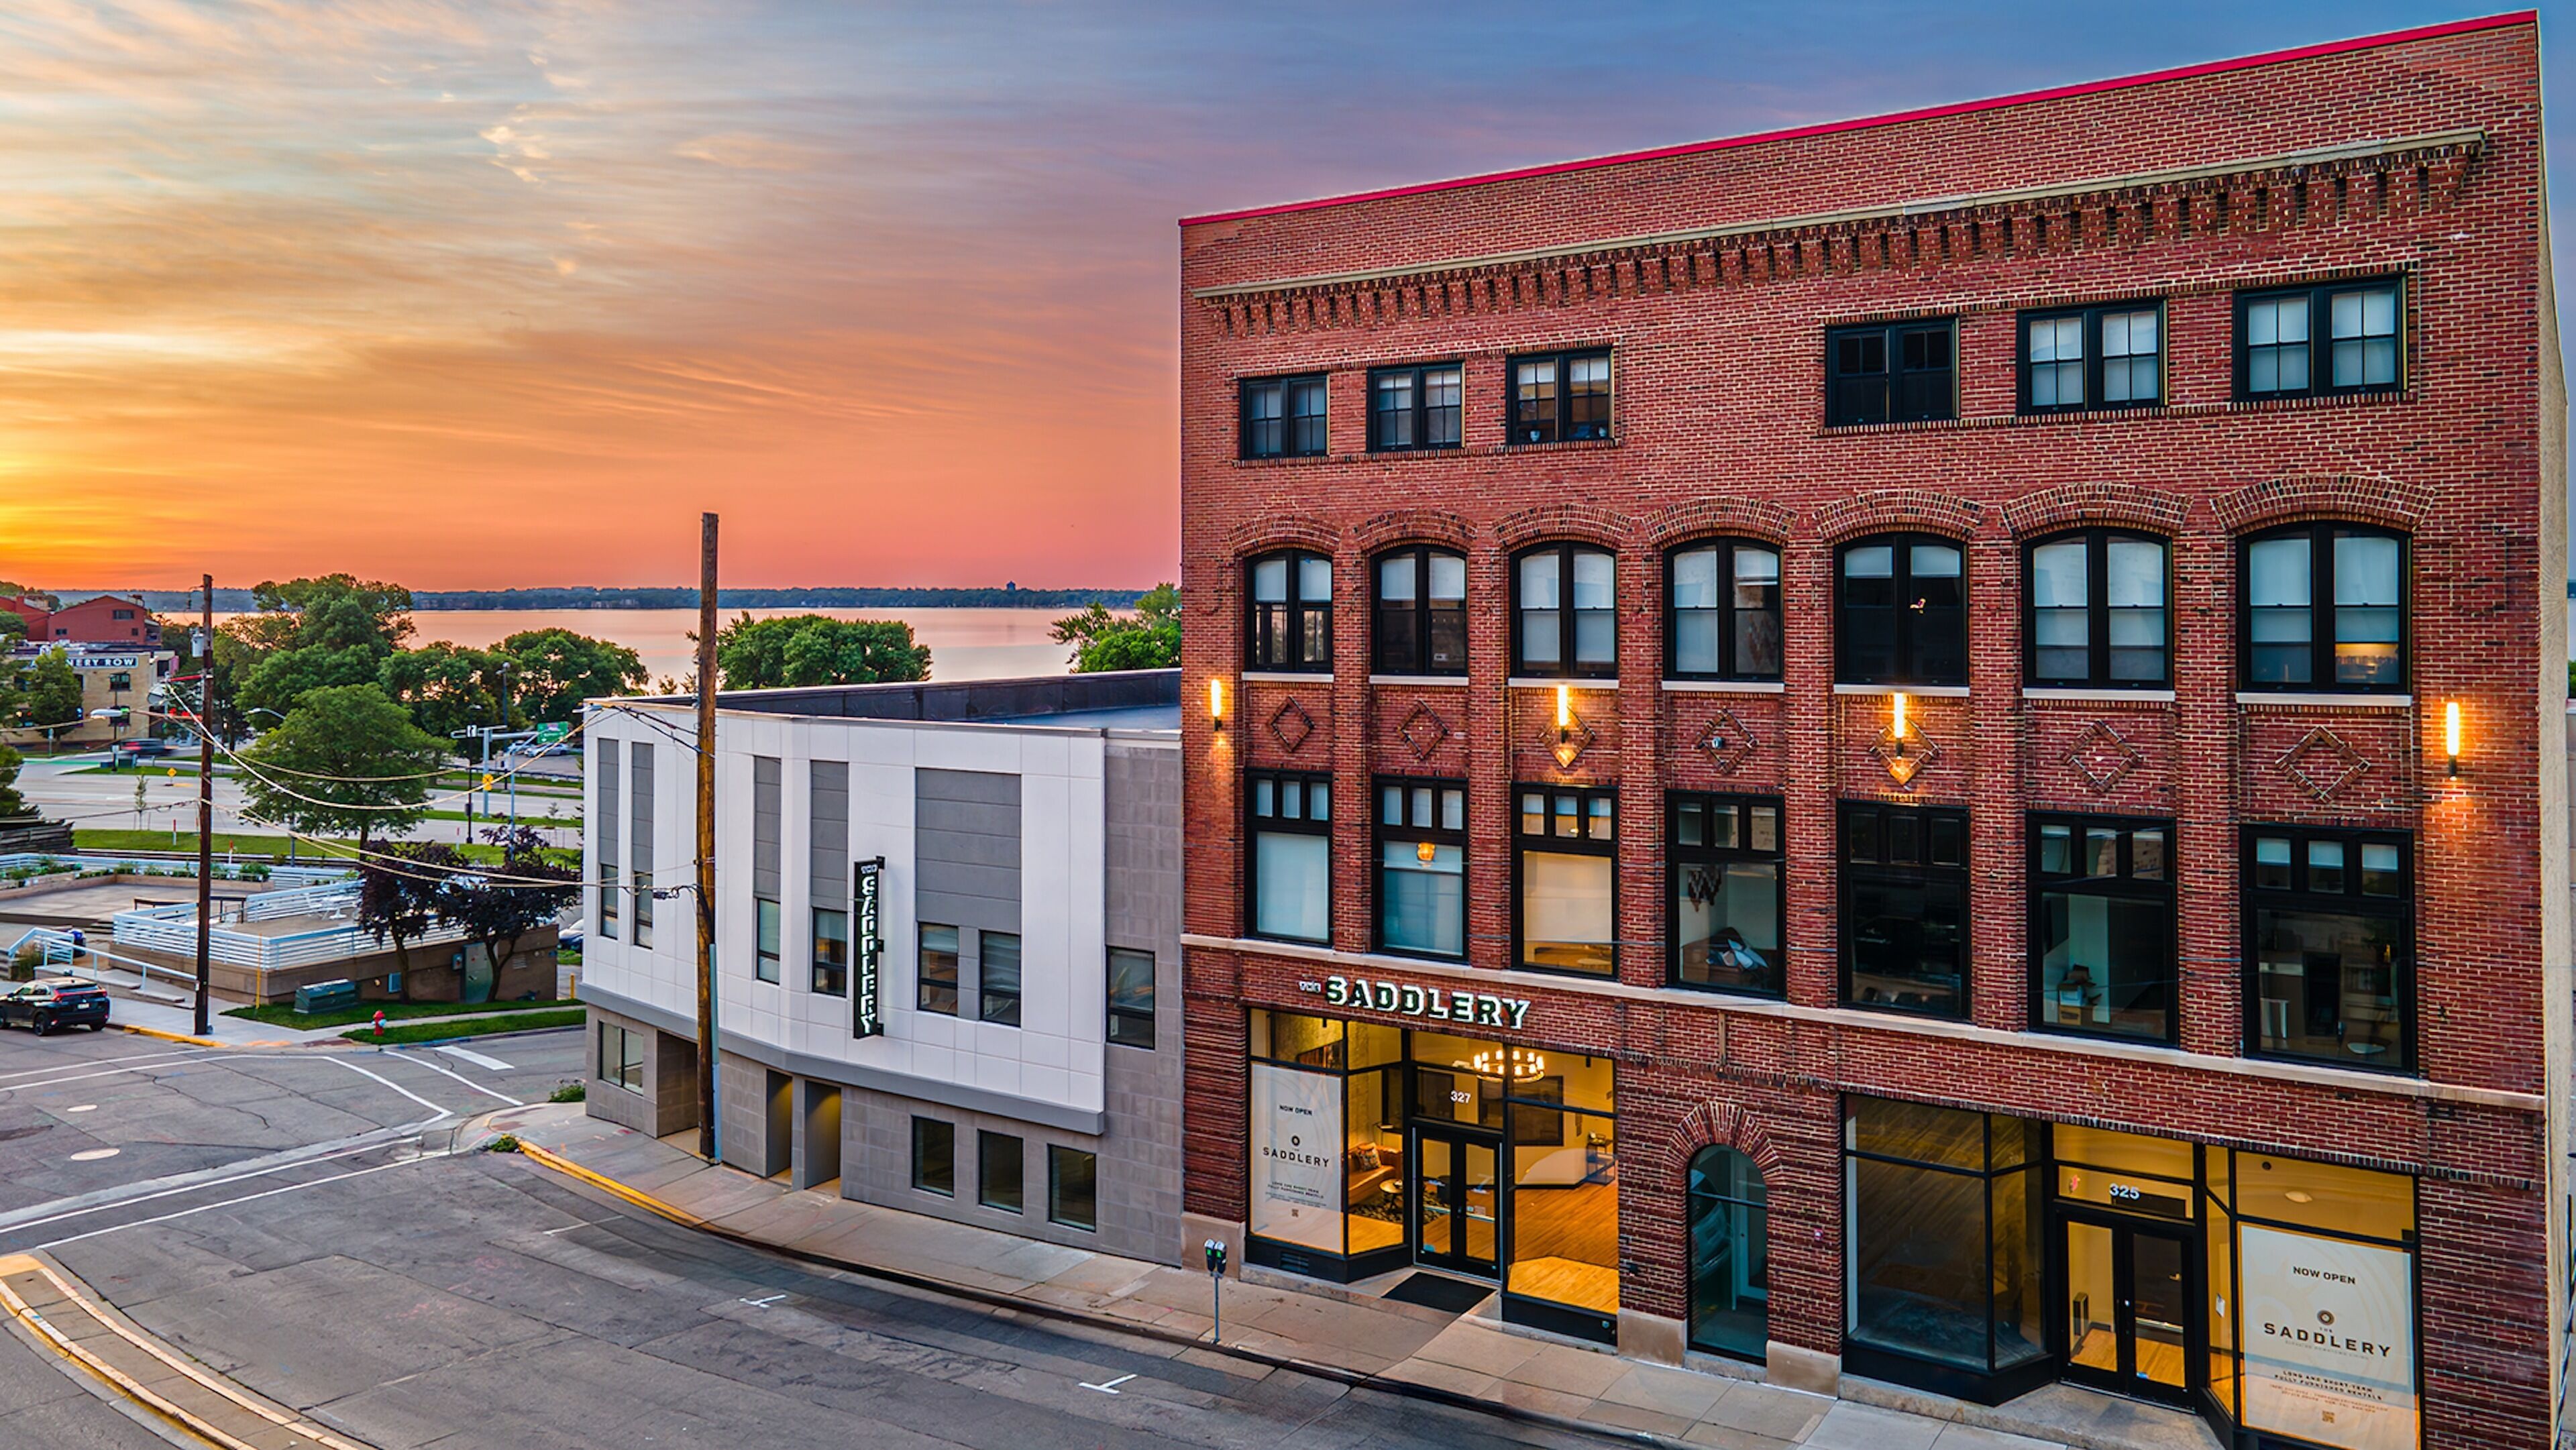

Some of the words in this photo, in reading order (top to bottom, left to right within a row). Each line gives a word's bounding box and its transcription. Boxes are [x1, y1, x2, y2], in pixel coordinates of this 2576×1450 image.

[105, 657, 134, 667] ROW
[861, 876, 875, 1034] SADDLERY
[1325, 975, 1530, 1029] SADDLERY
[1450, 1090, 1471, 1104] 327
[1295, 1107, 1313, 1116] OPEN
[1263, 1147, 1329, 1168] SADDLERY
[2109, 1182, 2140, 1201] 325
[2293, 1266, 2320, 1278] NOW
[2323, 1272, 2356, 1284] OPEN
[2264, 1323, 2391, 1357] SADDLERY
